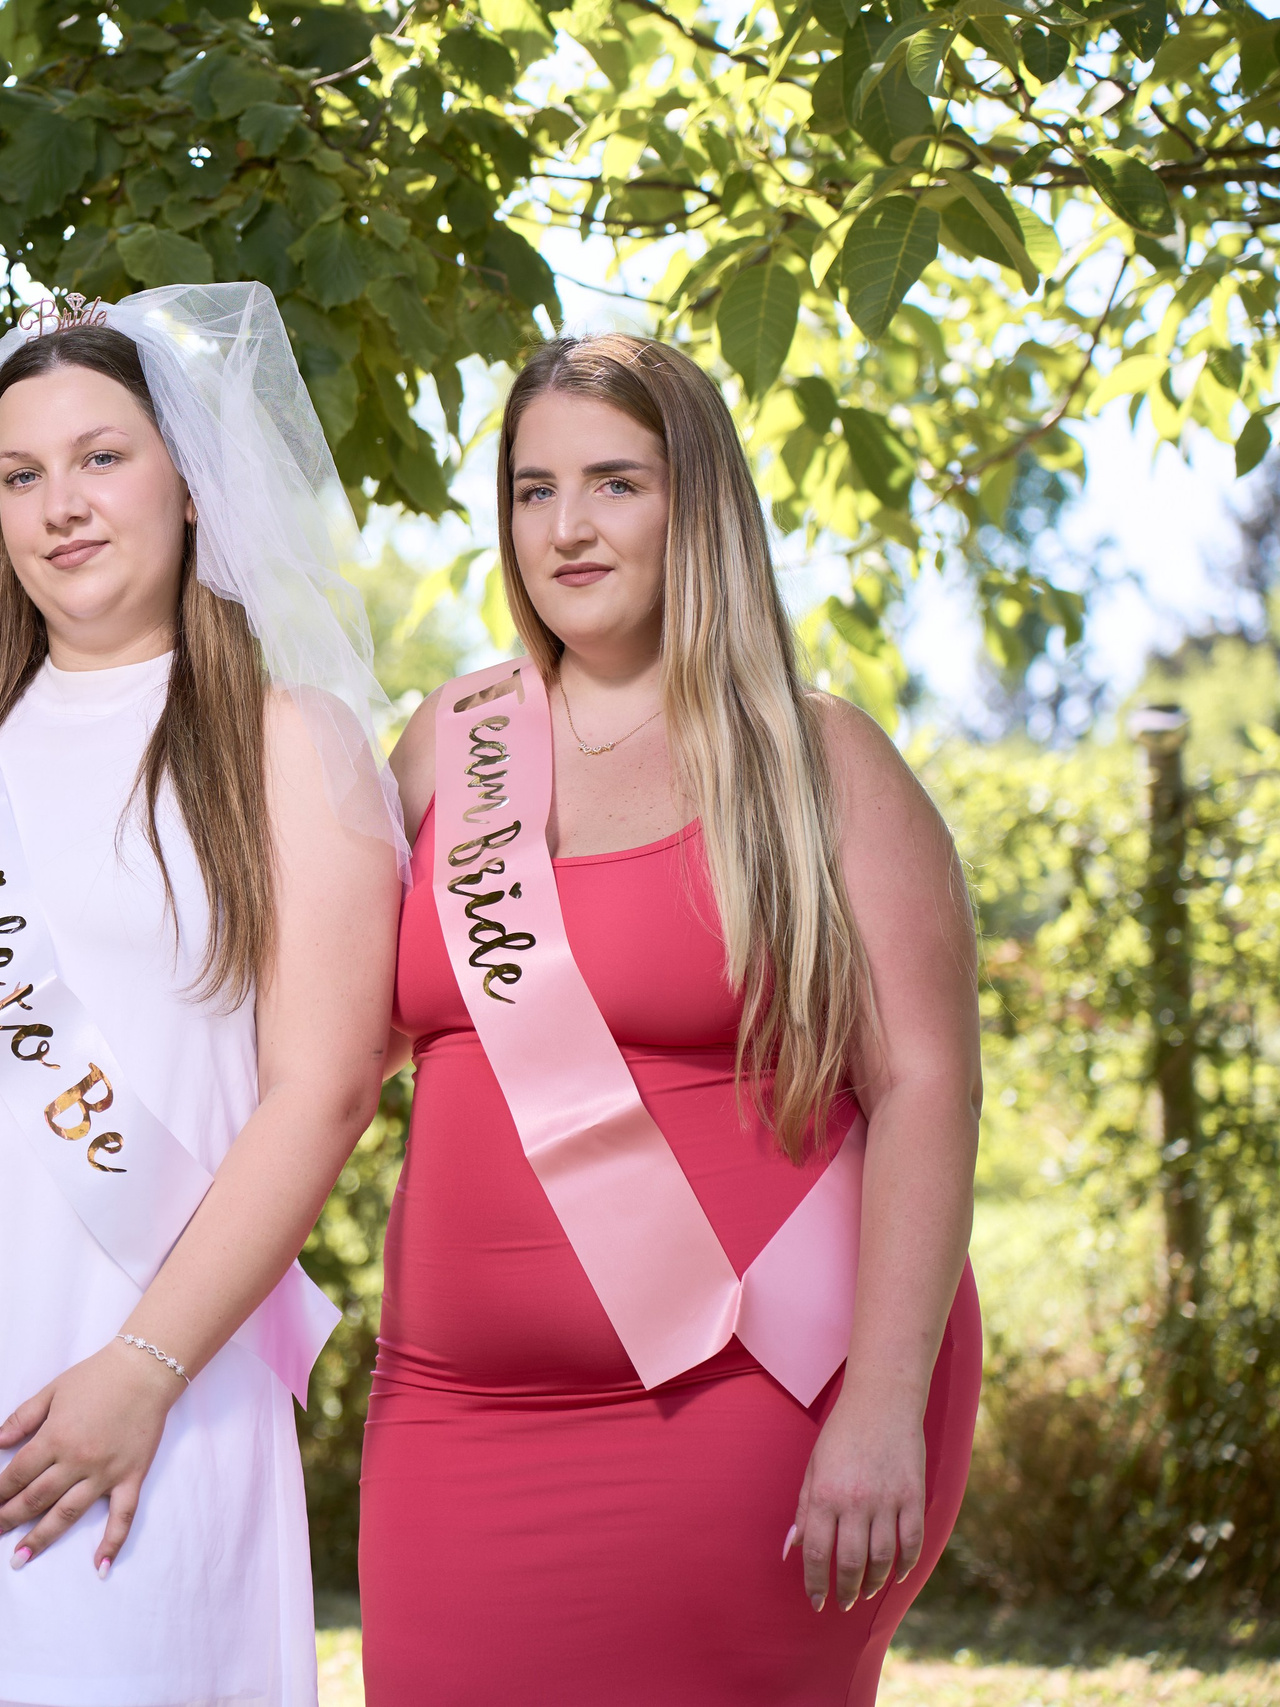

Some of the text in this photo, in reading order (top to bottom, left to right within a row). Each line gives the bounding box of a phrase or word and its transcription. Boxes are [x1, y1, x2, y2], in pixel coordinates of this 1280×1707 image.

[19, 293, 107, 344] Bride
[448, 668, 536, 1004] Team Bride
[44, 1062, 127, 1173] Be
